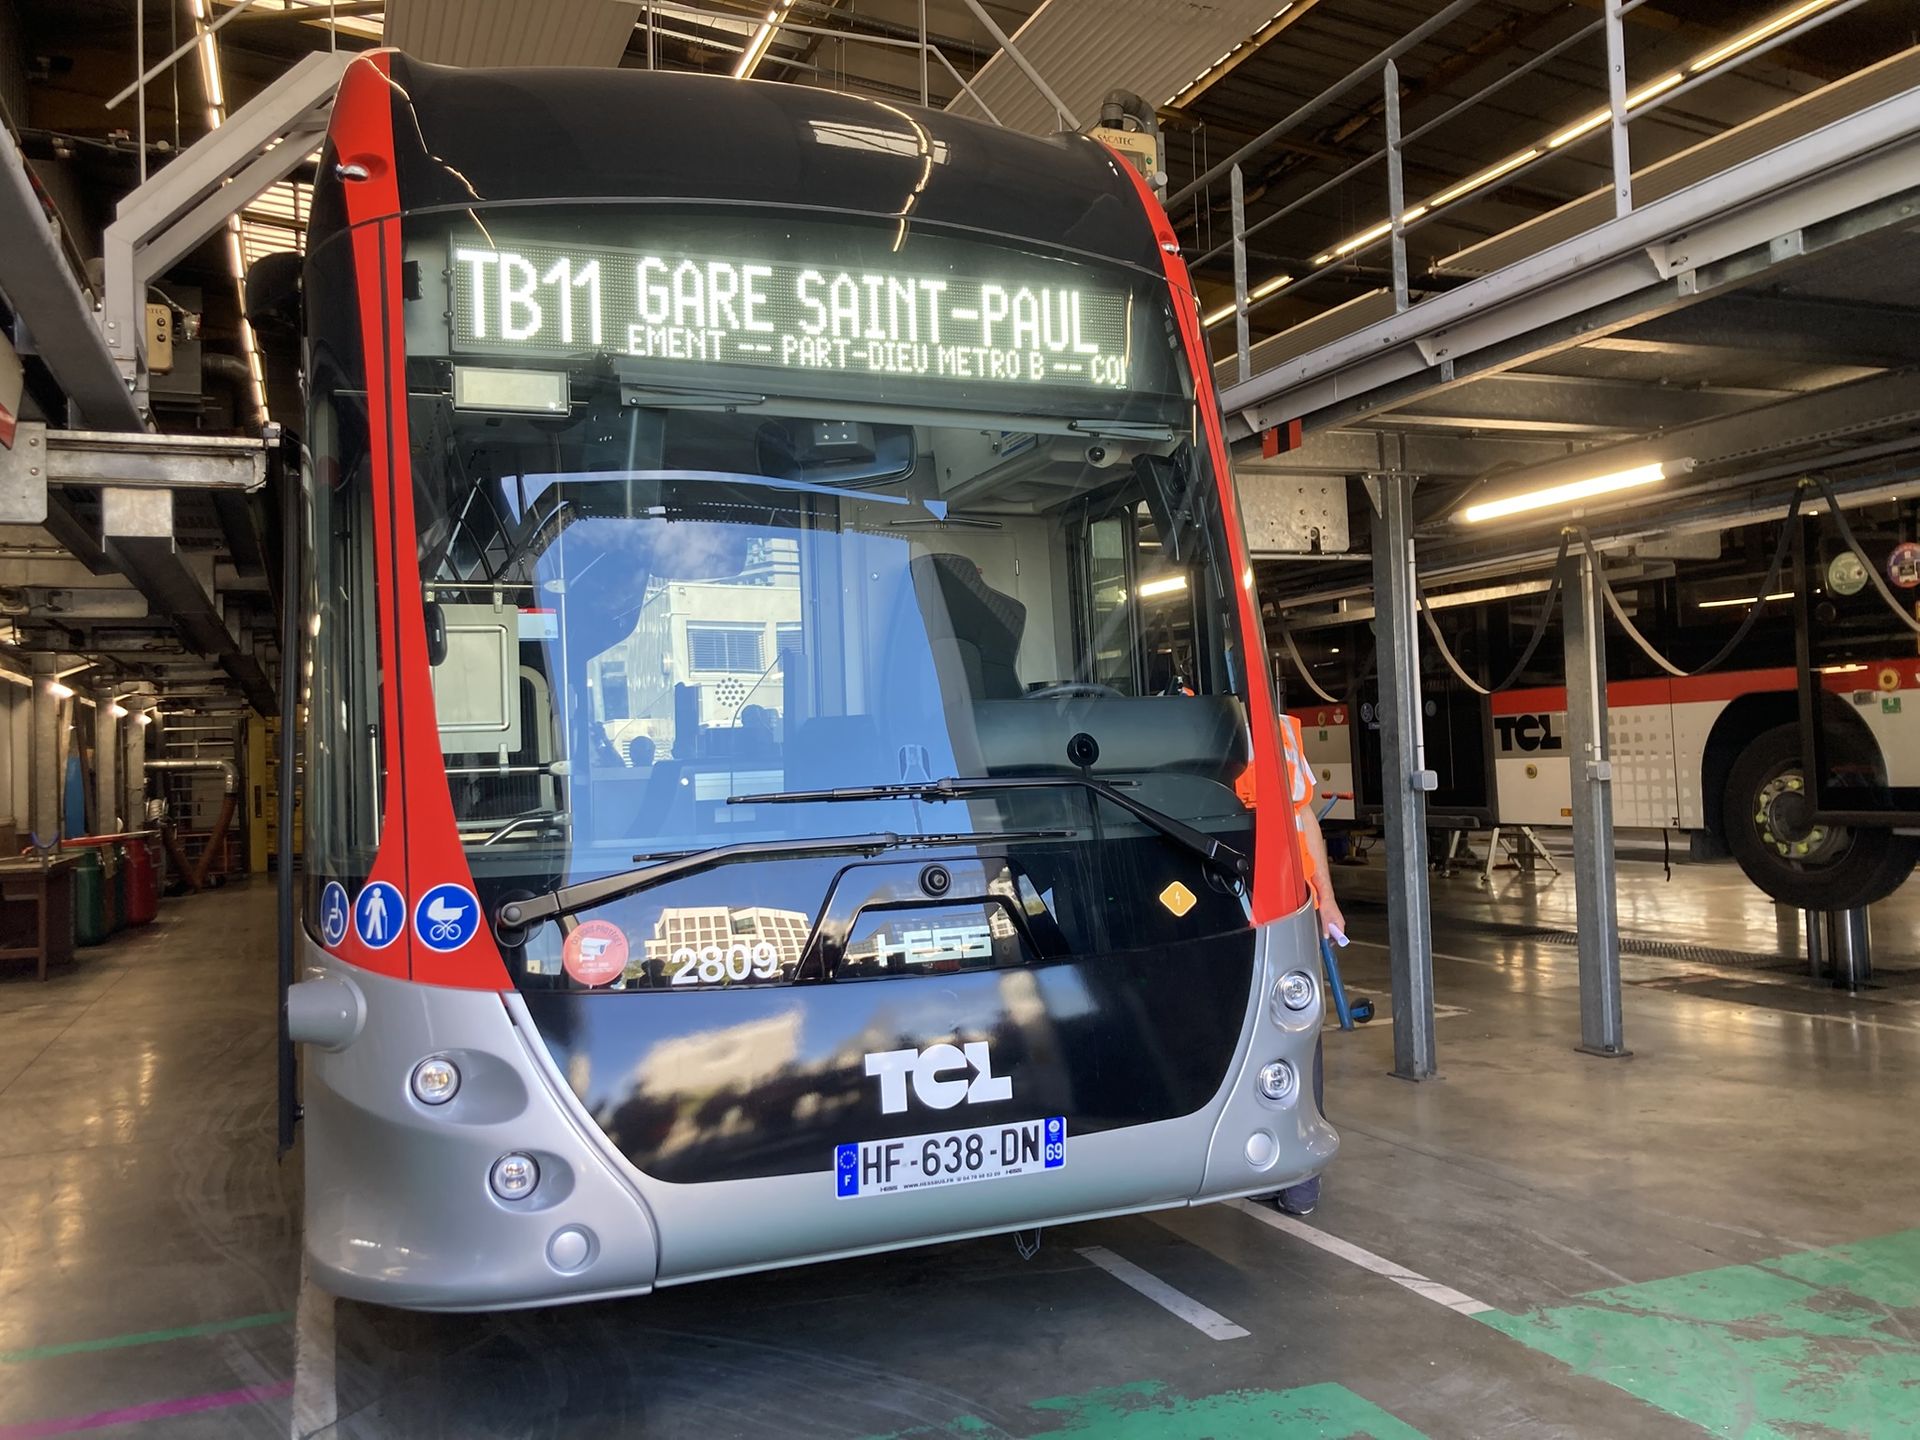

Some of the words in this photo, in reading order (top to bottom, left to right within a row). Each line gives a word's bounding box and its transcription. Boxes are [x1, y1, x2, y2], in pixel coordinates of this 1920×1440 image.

[457, 249, 602, 345] TB11
[636, 256, 774, 332] GARE
[797, 270, 1099, 353] SAINT-PAUL
[617, 324, 726, 361] EMENT
[782, 334, 928, 374] PART-DIEU
[937, 344, 1020, 379] METRO
[1029, 351, 1044, 381] B
[1494, 714, 1562, 751] TCL
[671, 942, 778, 985] 2809
[864, 1041, 1013, 1115] TCL
[862, 1125, 1040, 1186] HF-638-DN
[1046, 1142, 1063, 1161] 69
[844, 1174, 851, 1186] F
